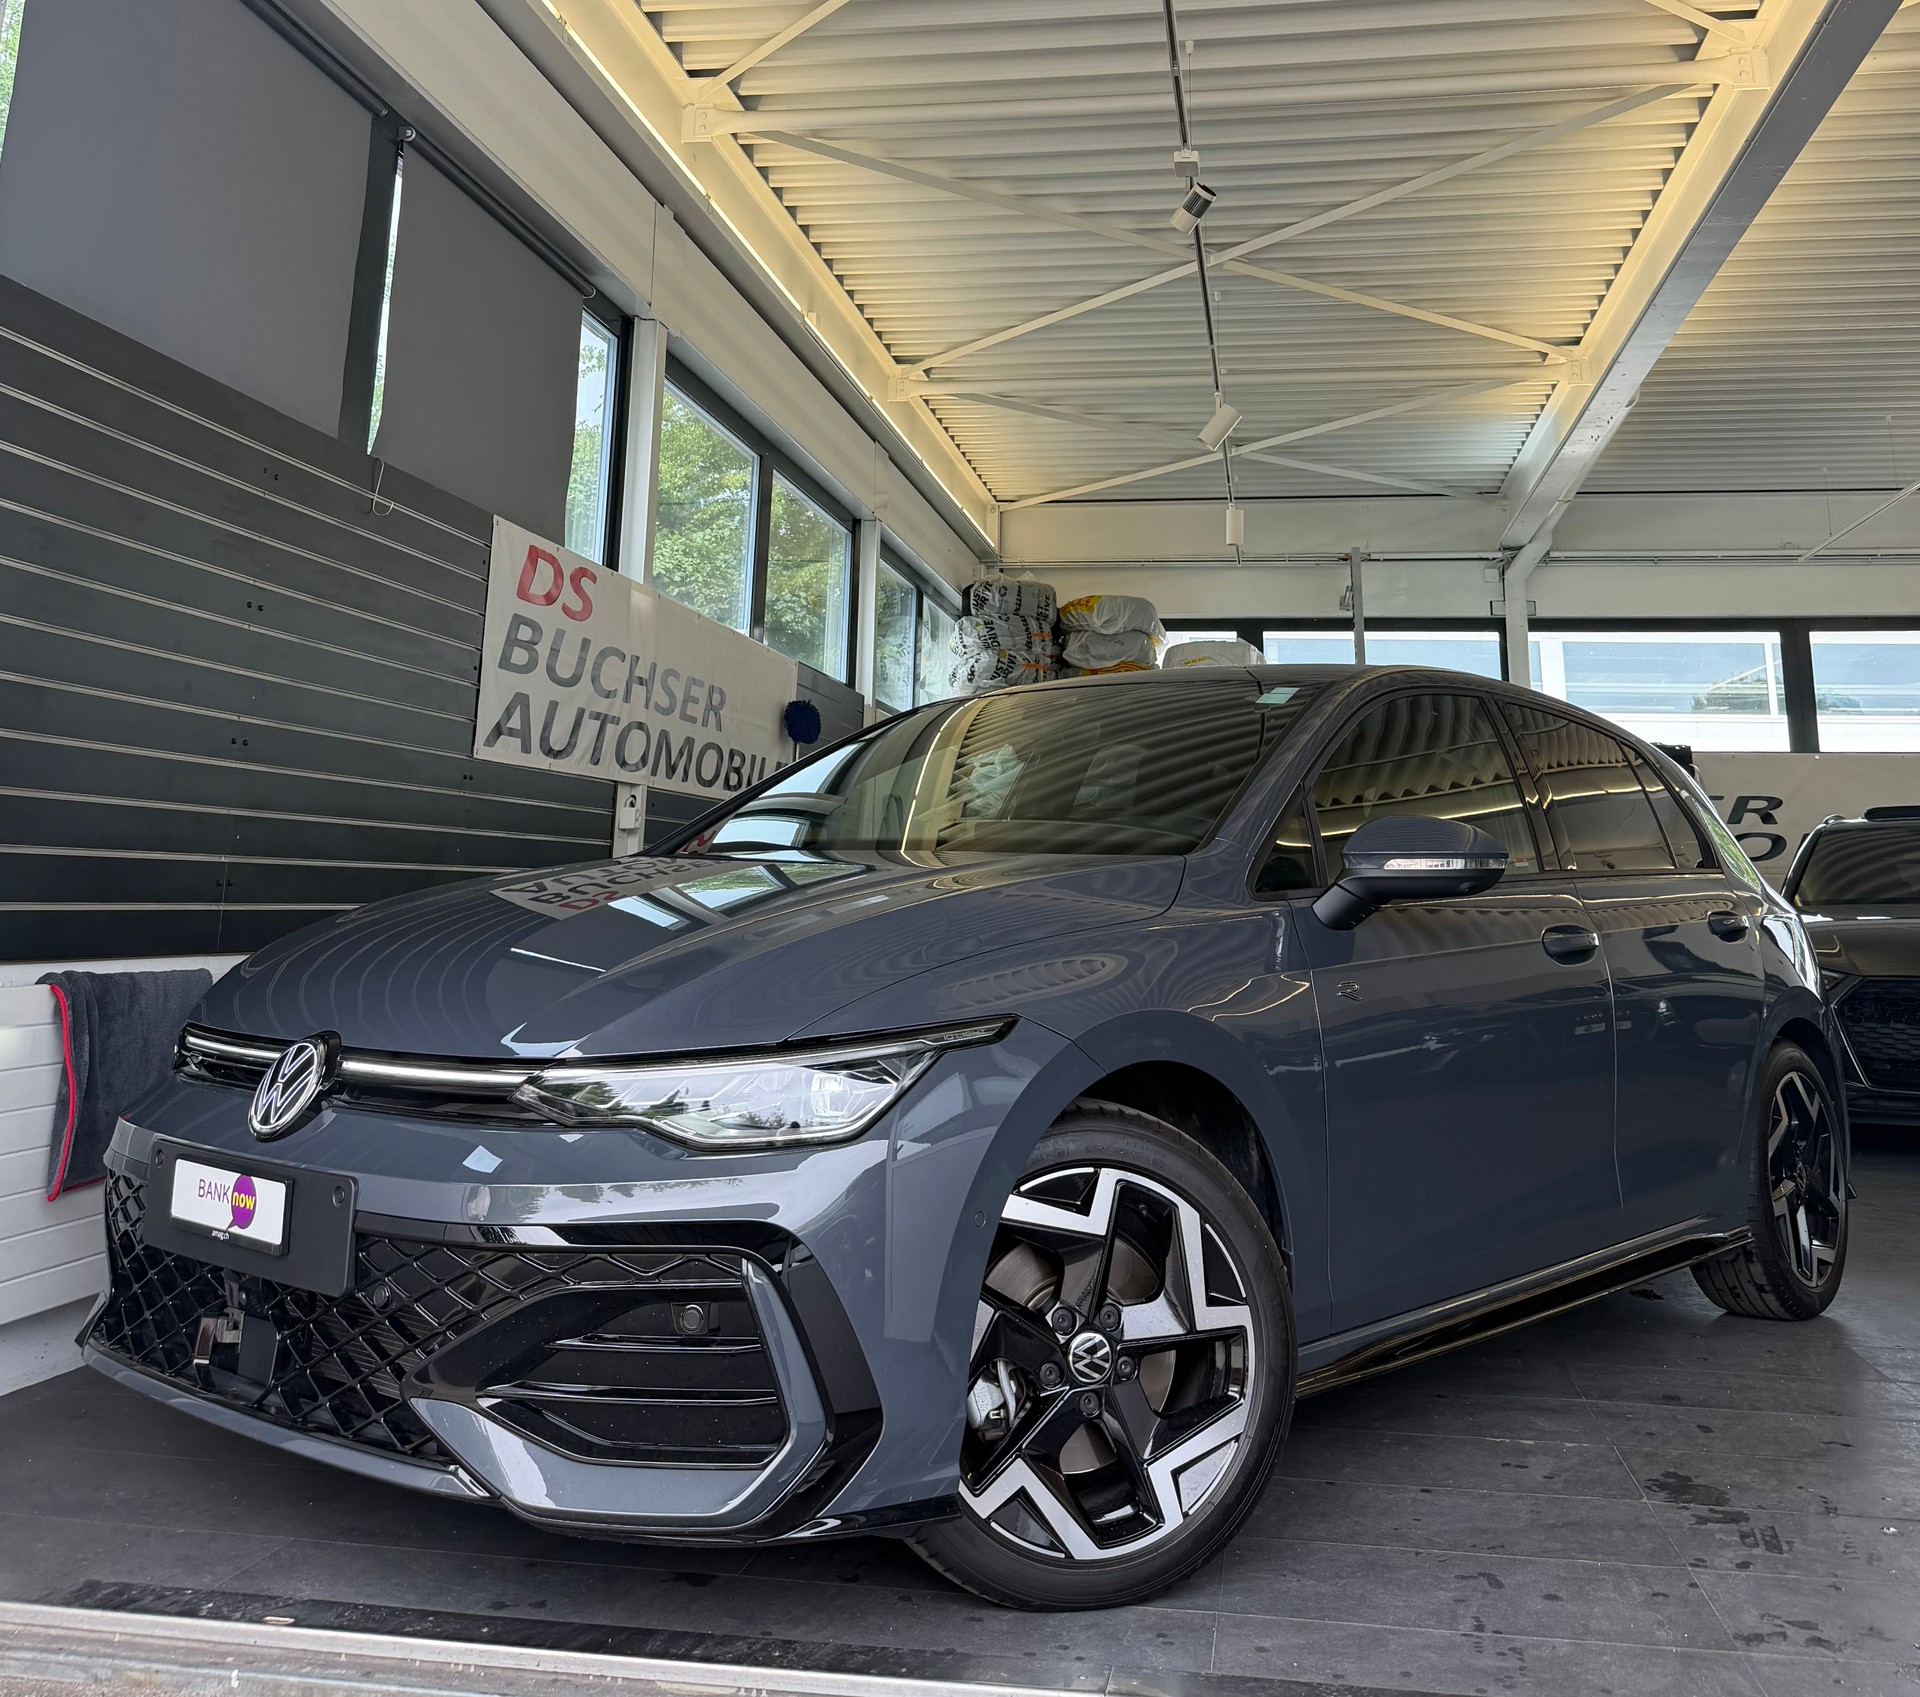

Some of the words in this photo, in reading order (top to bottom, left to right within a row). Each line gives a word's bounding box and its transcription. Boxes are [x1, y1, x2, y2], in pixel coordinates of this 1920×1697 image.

[516, 544, 598, 622] DS
[497, 612, 727, 732] BUCHSER
[483, 691, 788, 793] AUTOMOBI
[198, 1178, 231, 1204] BANK
[232, 1191, 256, 1210] now
